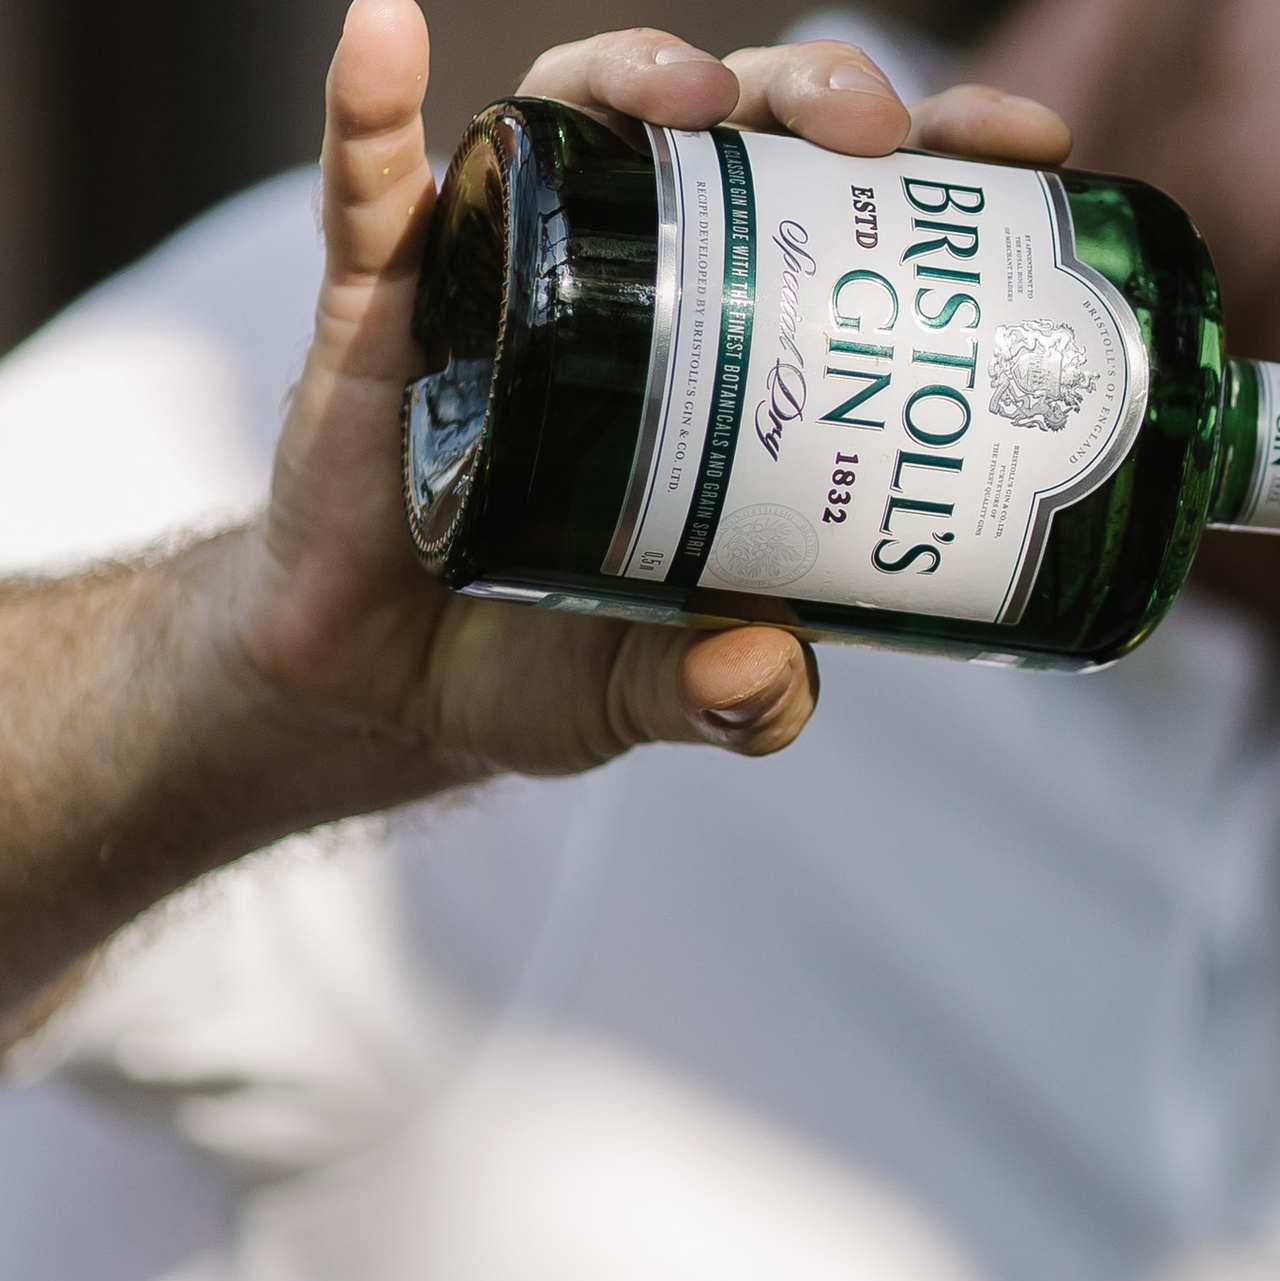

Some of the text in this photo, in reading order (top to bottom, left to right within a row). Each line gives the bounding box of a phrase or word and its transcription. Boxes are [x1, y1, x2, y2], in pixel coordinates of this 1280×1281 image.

[723, 149, 745, 185] CLASSIC
[730, 187, 747, 206] GIN
[731, 209, 749, 241] MADE
[731, 245, 749, 277] WITH
[730, 281, 748, 309] THE
[1027, 289, 1034, 299] TO
[667, 181, 709, 493] RECIPE DEVELOPED BY BRISTOLL'S GIN & CO. LTD.
[725, 311, 747, 359] FINEST
[755, 219, 816, 462] Special Dry
[815, 184, 899, 524] ESTD GIN 1832
[871, 175, 985, 575] BRISTOLL'S
[1069, 300, 1116, 464] BRISTOLL'S OF ENGLAND
[713, 364, 741, 448] BOTANICALS
[706, 452, 727, 478] AND
[1007, 445, 1020, 488] BRISTOLL'S
[696, 482, 720, 519] GRAIN
[975, 442, 1000, 536] THE FINEST QUALITY GINS
[990, 464, 1006, 519] PURVEYORS OF
[1004, 489, 1012, 503] GIN
[684, 522, 709, 557] SPIRIT
